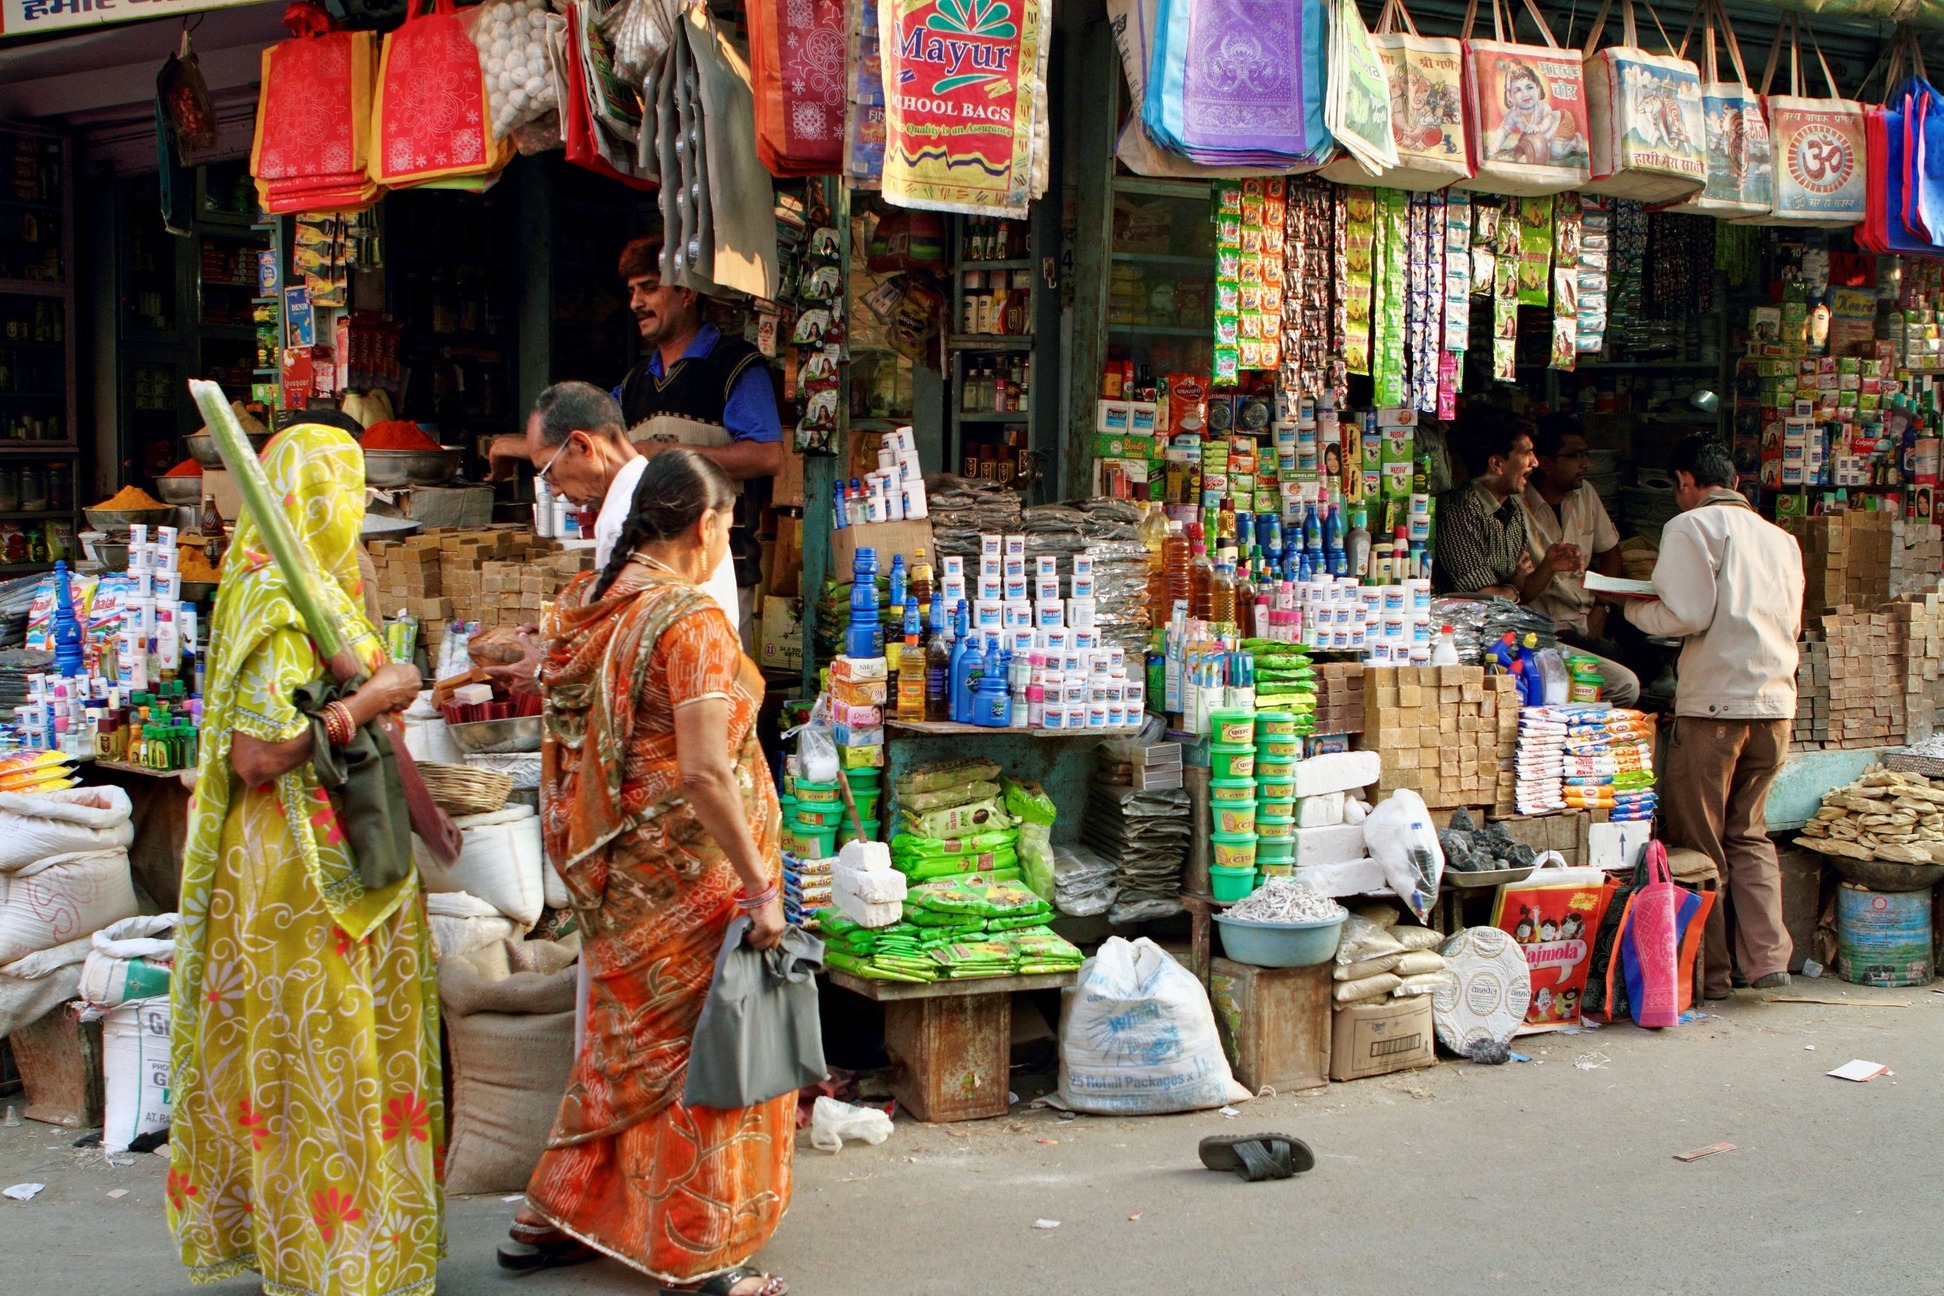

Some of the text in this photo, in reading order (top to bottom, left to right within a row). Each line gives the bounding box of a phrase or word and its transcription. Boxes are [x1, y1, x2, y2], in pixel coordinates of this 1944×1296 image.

[893, 21, 1012, 76] Mayur
[1419, 56, 1434, 70] श्री
[1551, 80, 1577, 100] चोर
[961, 103, 1011, 121] BAGS
[906, 123, 940, 139] Quality
[941, 126, 950, 135] is
[951, 126, 964, 135] an
[966, 123, 1012, 137] Assurance
[1633, 152, 1704, 174] हाथी मेरा साथी
[1855, 438, 1876, 447] Colgate
[1070, 1076, 1084, 1088] 25
[1086, 1074, 1122, 1089] Retail
[1125, 1072, 1184, 1090] Packages
[1186, 1073, 1194, 1081] x
